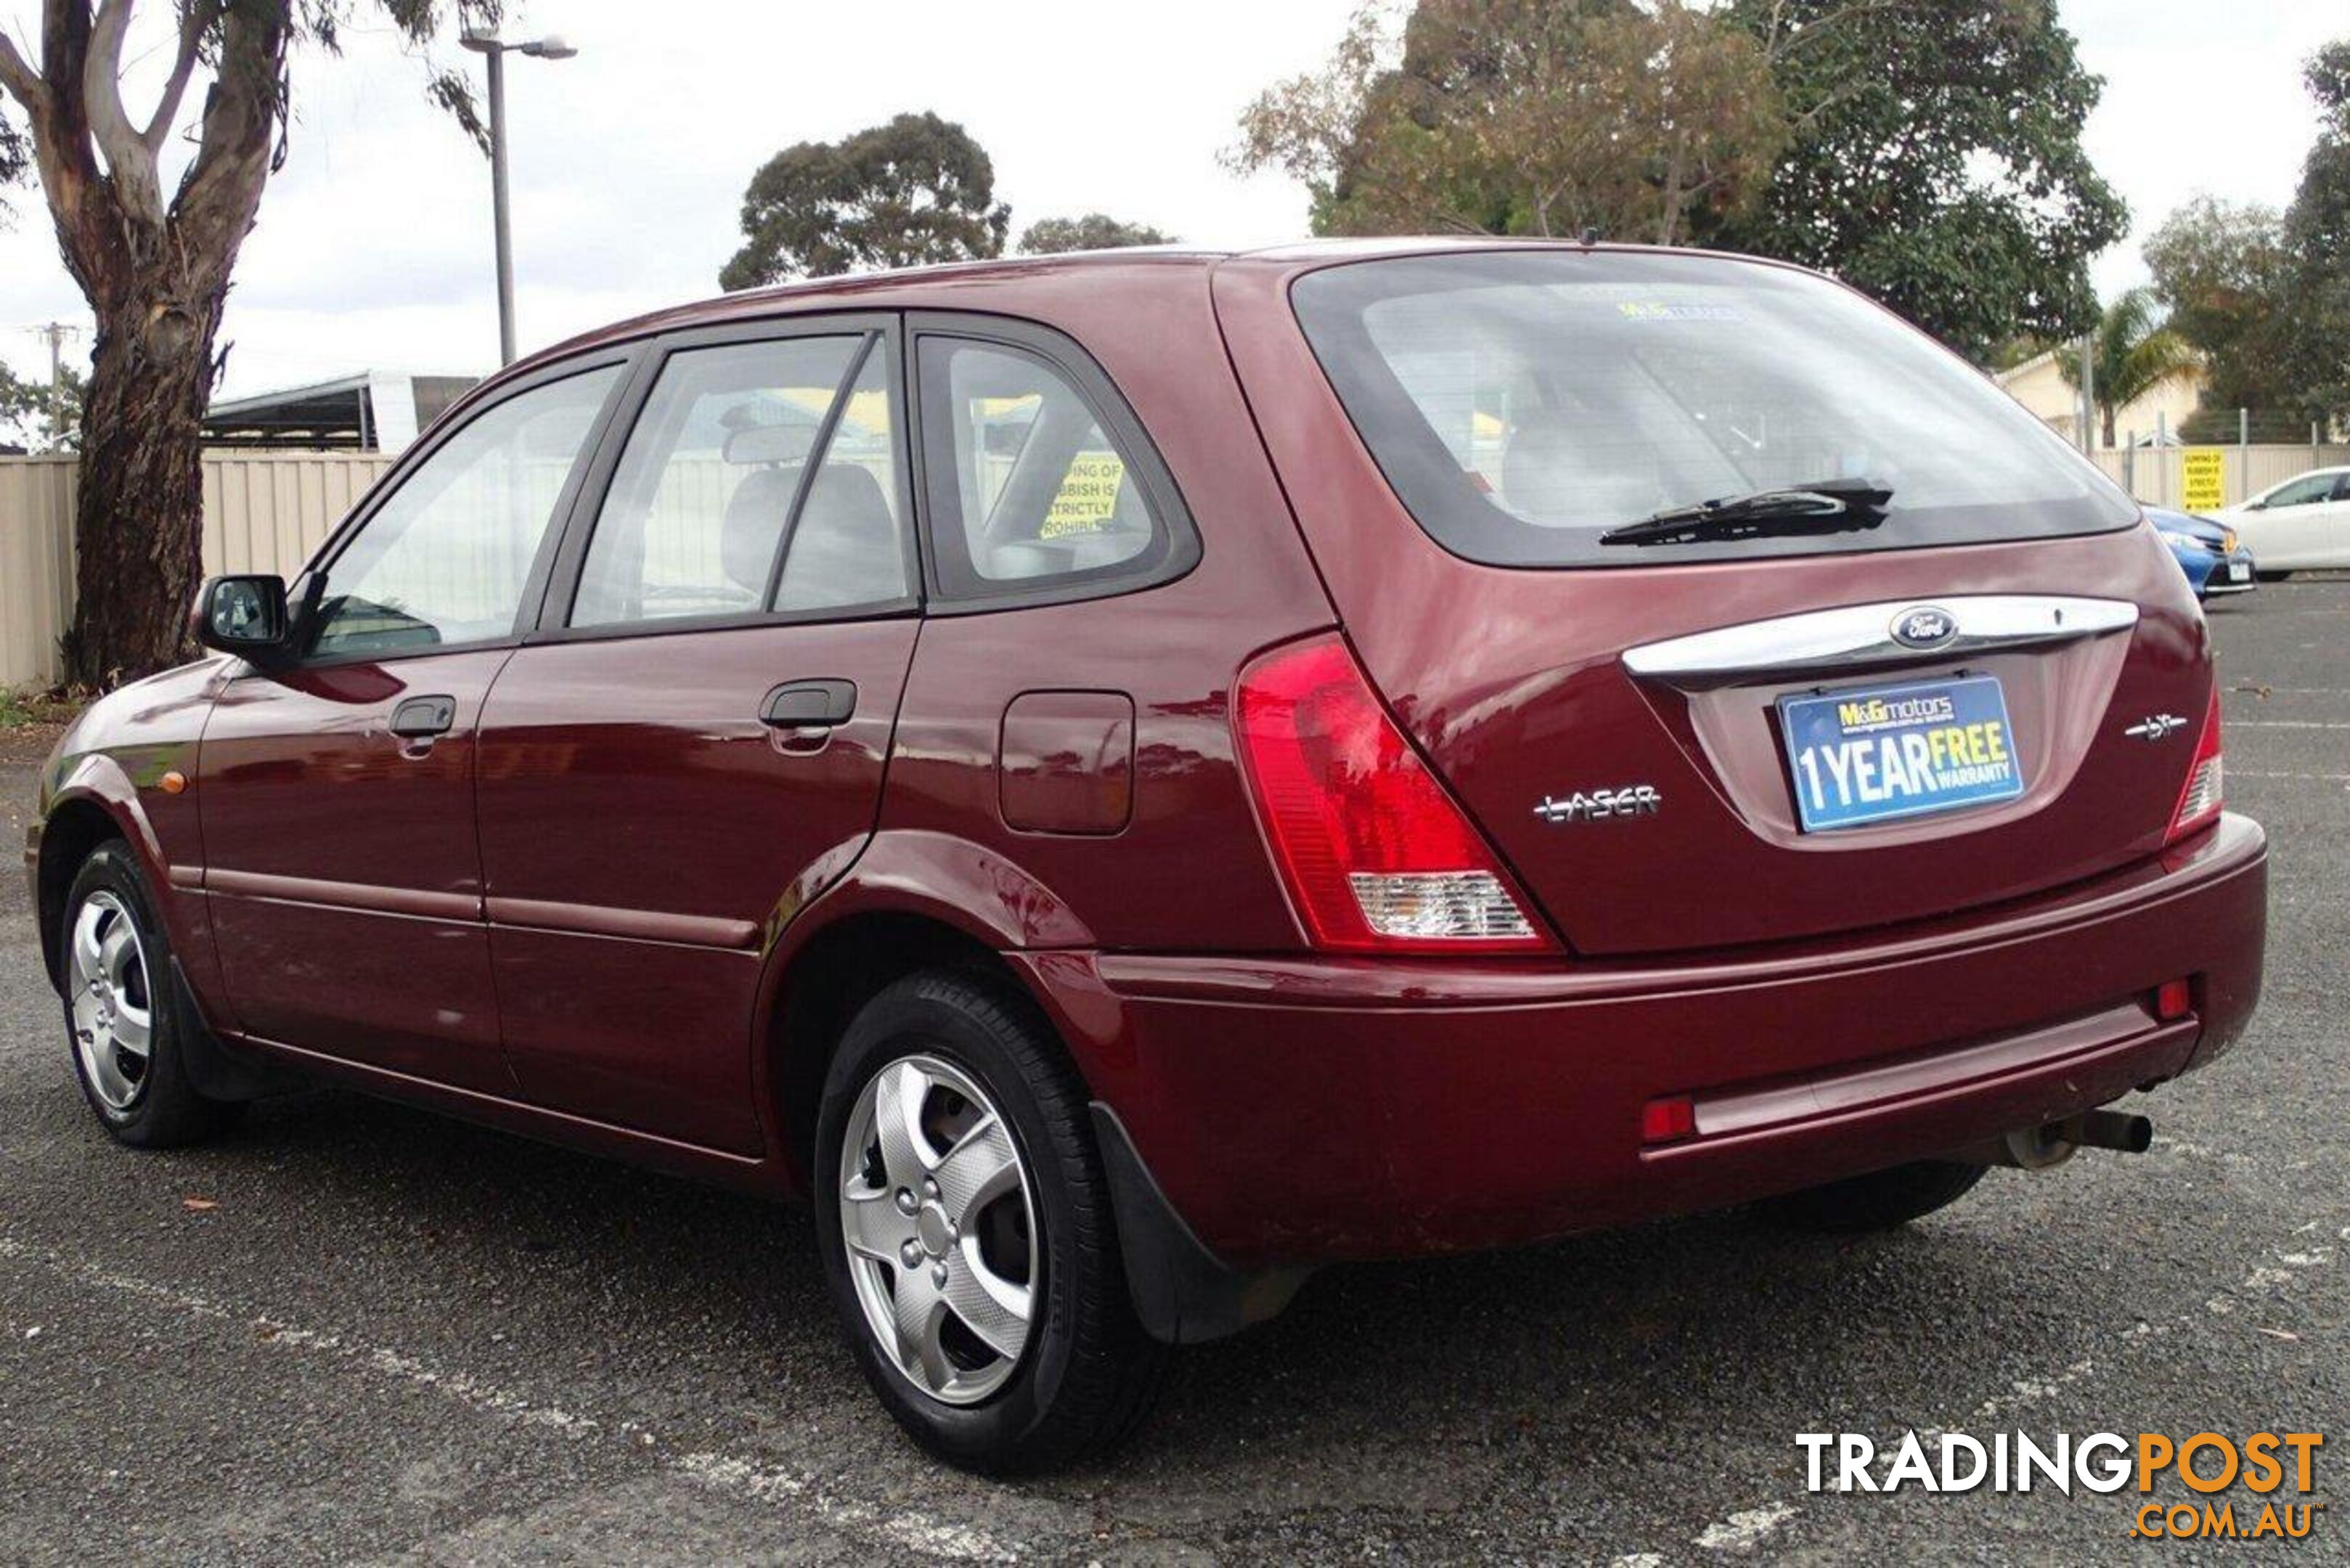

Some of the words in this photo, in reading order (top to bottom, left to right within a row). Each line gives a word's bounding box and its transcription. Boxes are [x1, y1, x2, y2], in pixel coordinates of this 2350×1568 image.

[1101, 464, 1121, 477] OF
[1103, 482, 1114, 496] IS
[1800, 746, 1825, 809] 1
[1821, 733, 1939, 806] YEAR
[1927, 721, 2008, 769] FREE
[1937, 761, 2010, 790] WARRANTY
[1534, 785, 1662, 822] LASER
